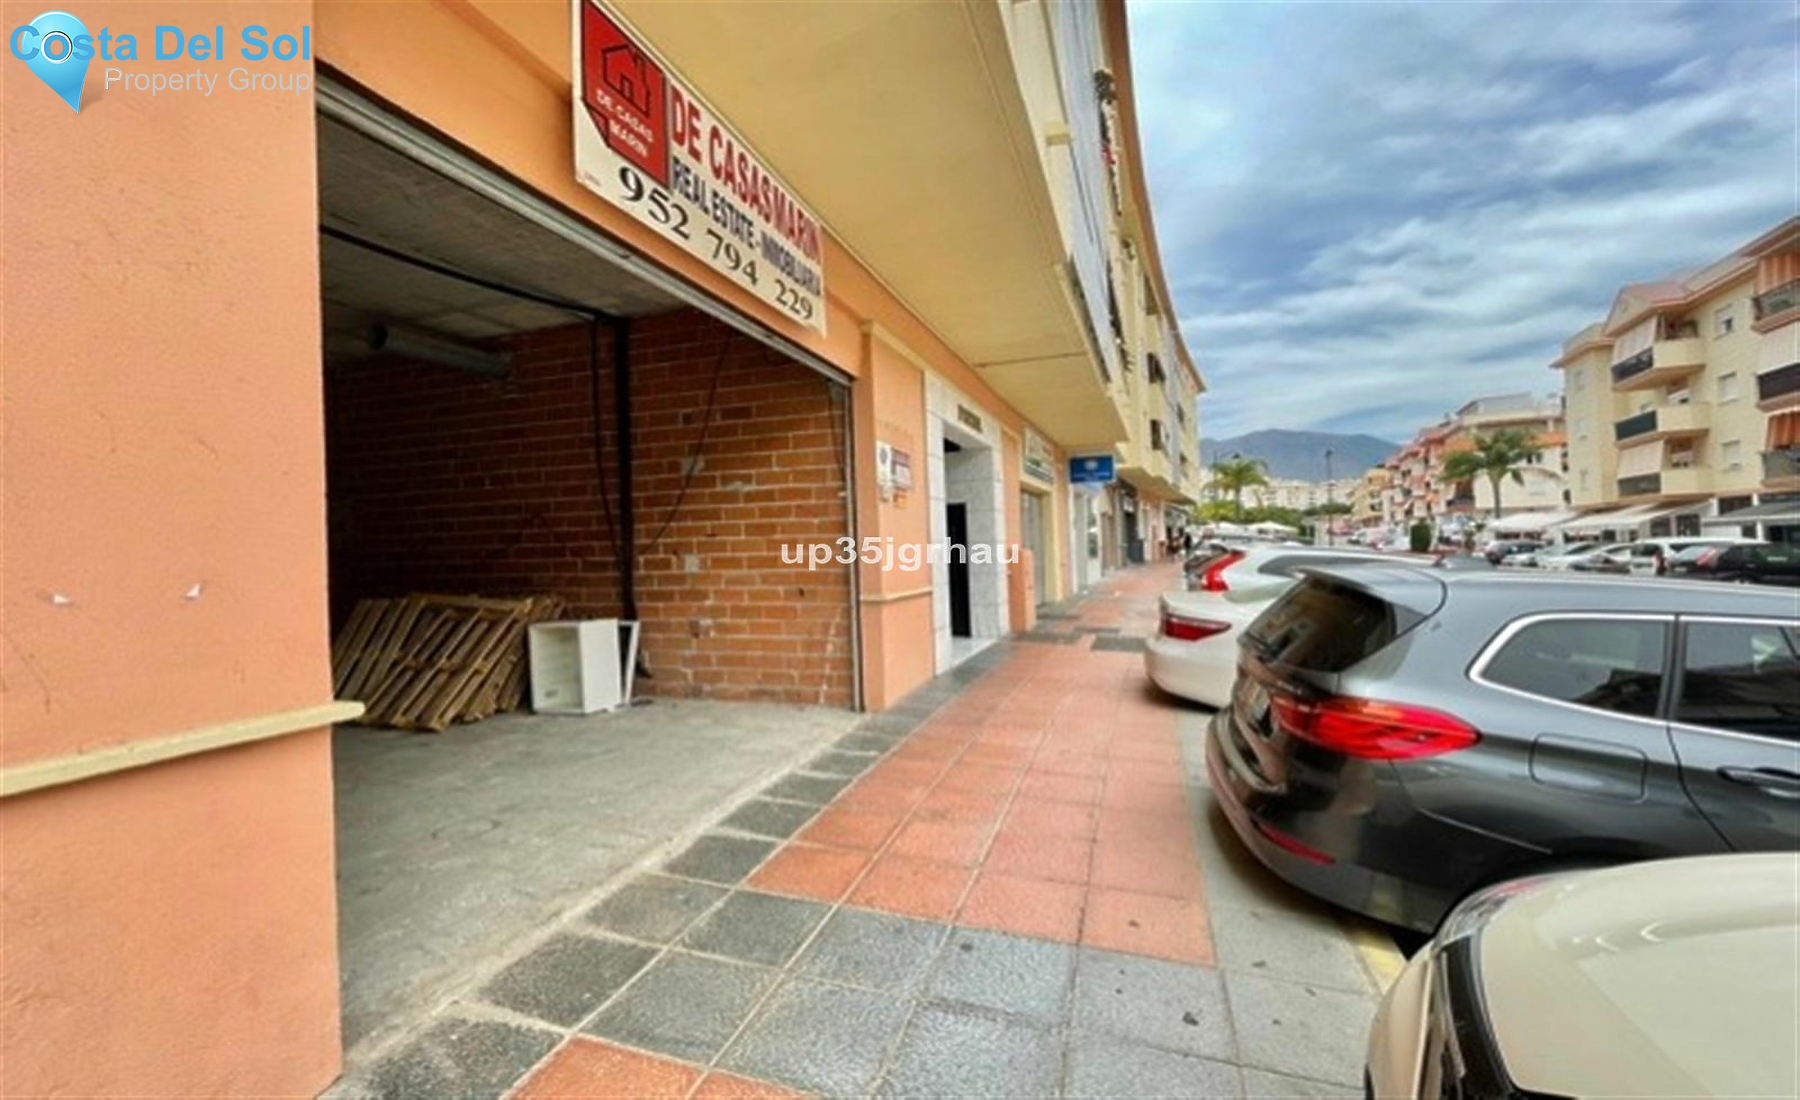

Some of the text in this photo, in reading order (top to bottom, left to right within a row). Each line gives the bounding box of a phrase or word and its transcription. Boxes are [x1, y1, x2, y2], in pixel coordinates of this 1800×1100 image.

[618, 166, 813, 320] 952 794 229
[671, 85, 821, 265] DE CASASMARIN
[672, 155, 710, 216] REAL
[712, 189, 754, 250] ESTATE
